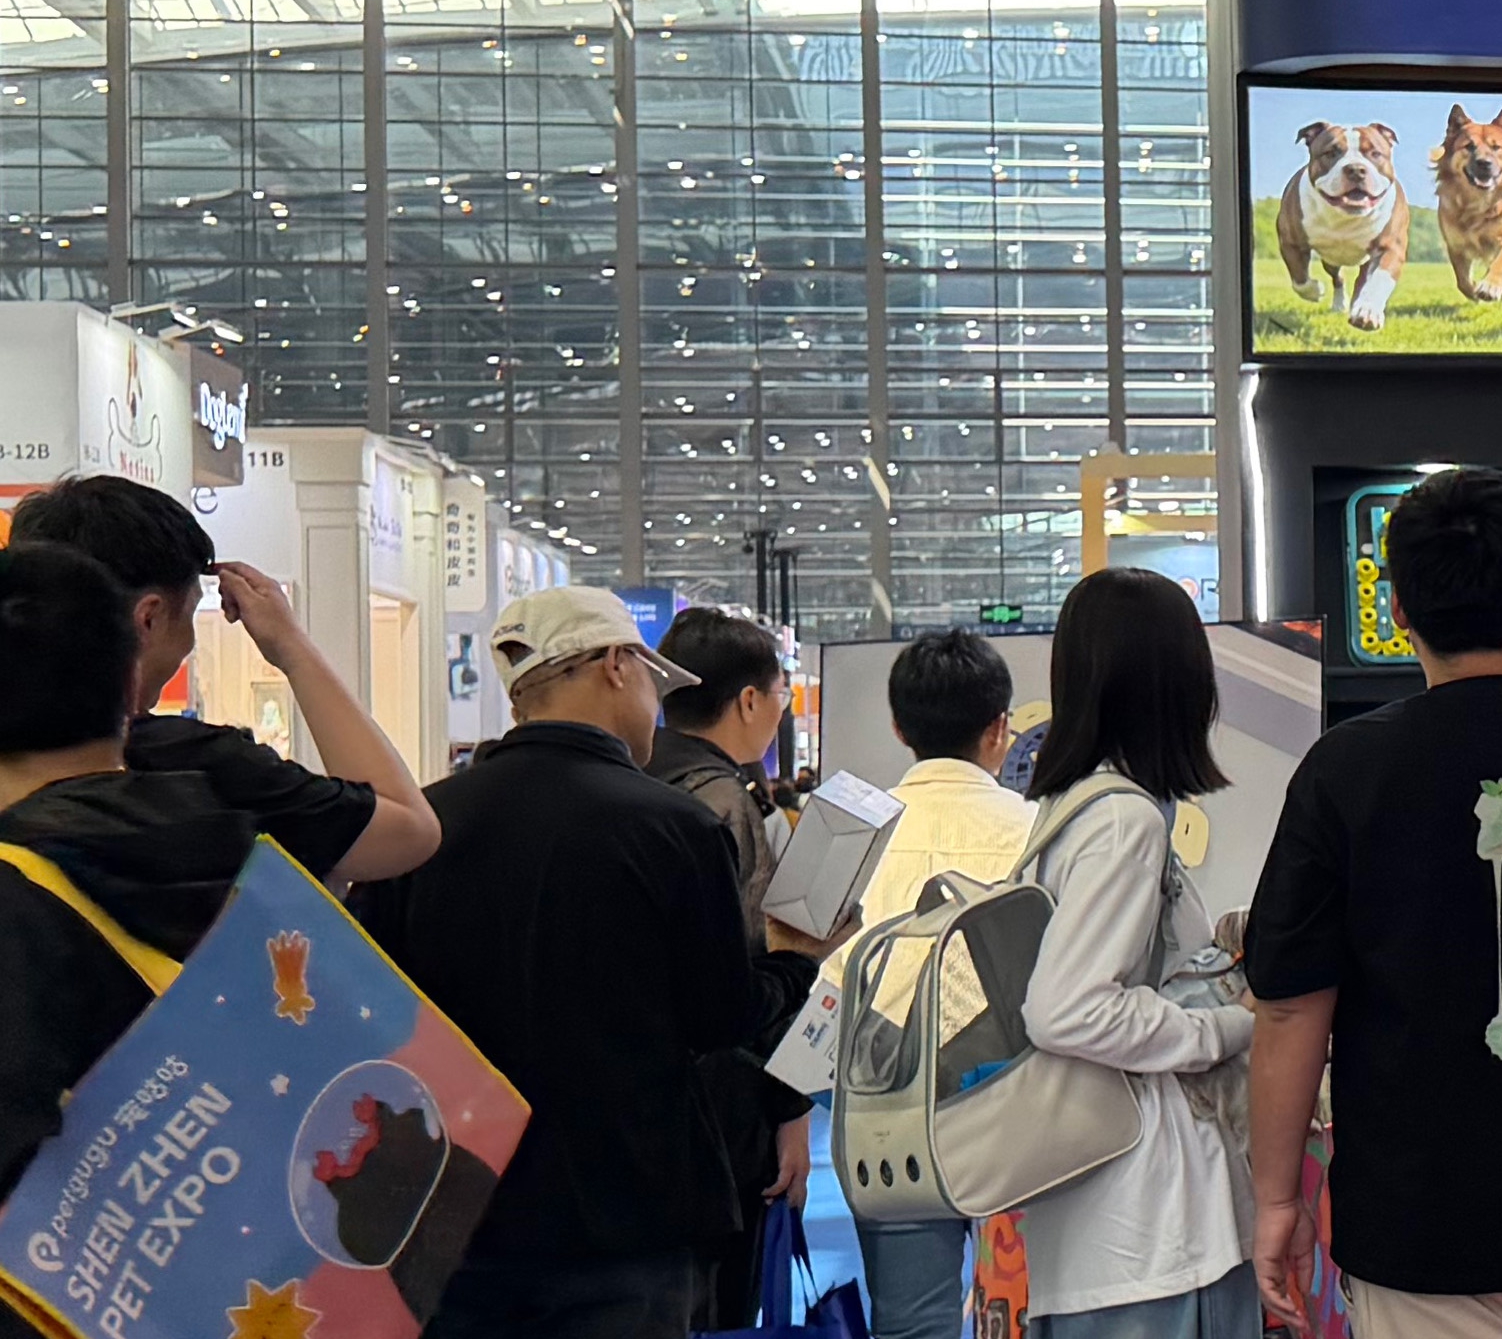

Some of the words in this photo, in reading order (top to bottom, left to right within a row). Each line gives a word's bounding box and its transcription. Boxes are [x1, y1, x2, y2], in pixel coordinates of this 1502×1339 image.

[52, 1126, 118, 1239] petgugu
[67, 1199, 136, 1311] SHEN
[117, 1082, 232, 1205] ZHEN
[137, 1146, 241, 1267] EXPO
